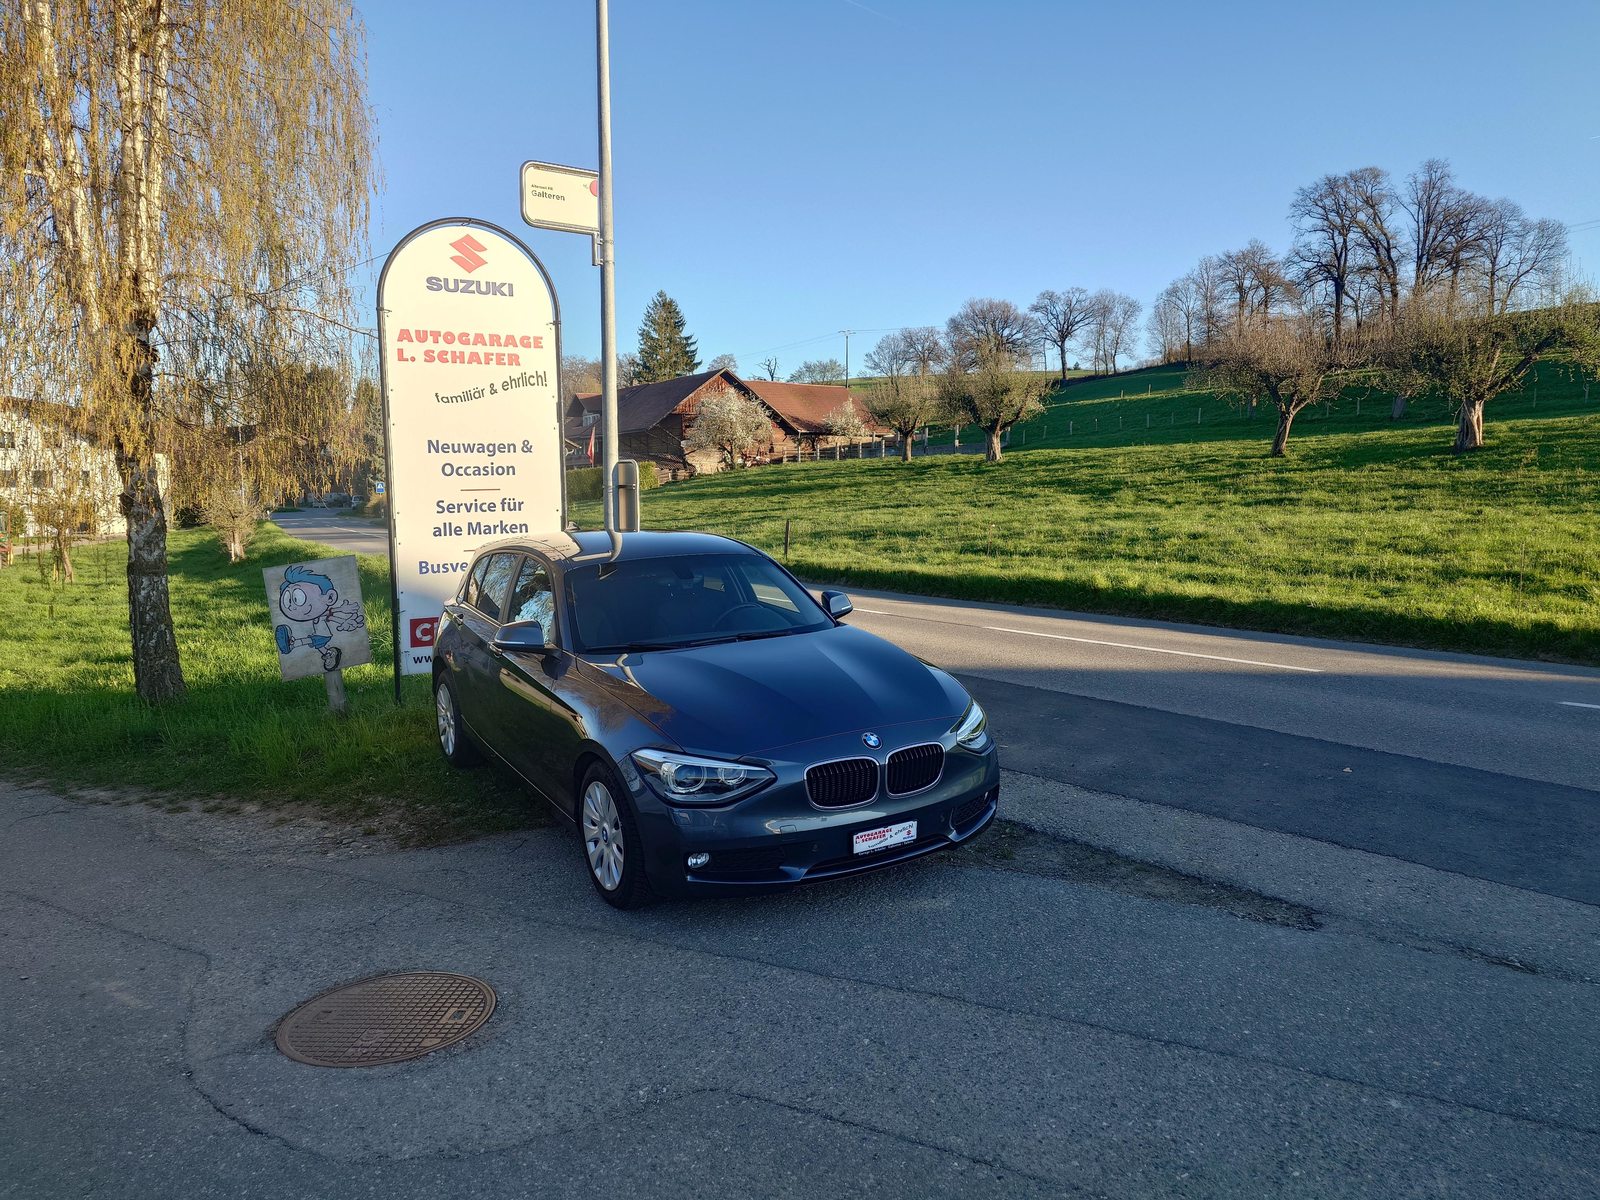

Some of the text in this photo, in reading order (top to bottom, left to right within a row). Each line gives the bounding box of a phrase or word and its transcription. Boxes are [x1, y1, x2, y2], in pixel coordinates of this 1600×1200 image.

[531, 189, 565, 201] Galteren
[426, 276, 514, 297] SUZUKI
[397, 328, 544, 349] AUTOGARAGE
[397, 348, 521, 367] L. SCHAFER
[434, 370, 548, 404] familiär & ehrlich!
[427, 439, 533, 457] Neuwagen &
[441, 462, 516, 477] Occasion
[436, 498, 525, 514] Service für
[432, 521, 529, 538] alle Marken
[418, 560, 469, 575] Busve
[412, 655, 433, 664] ww
